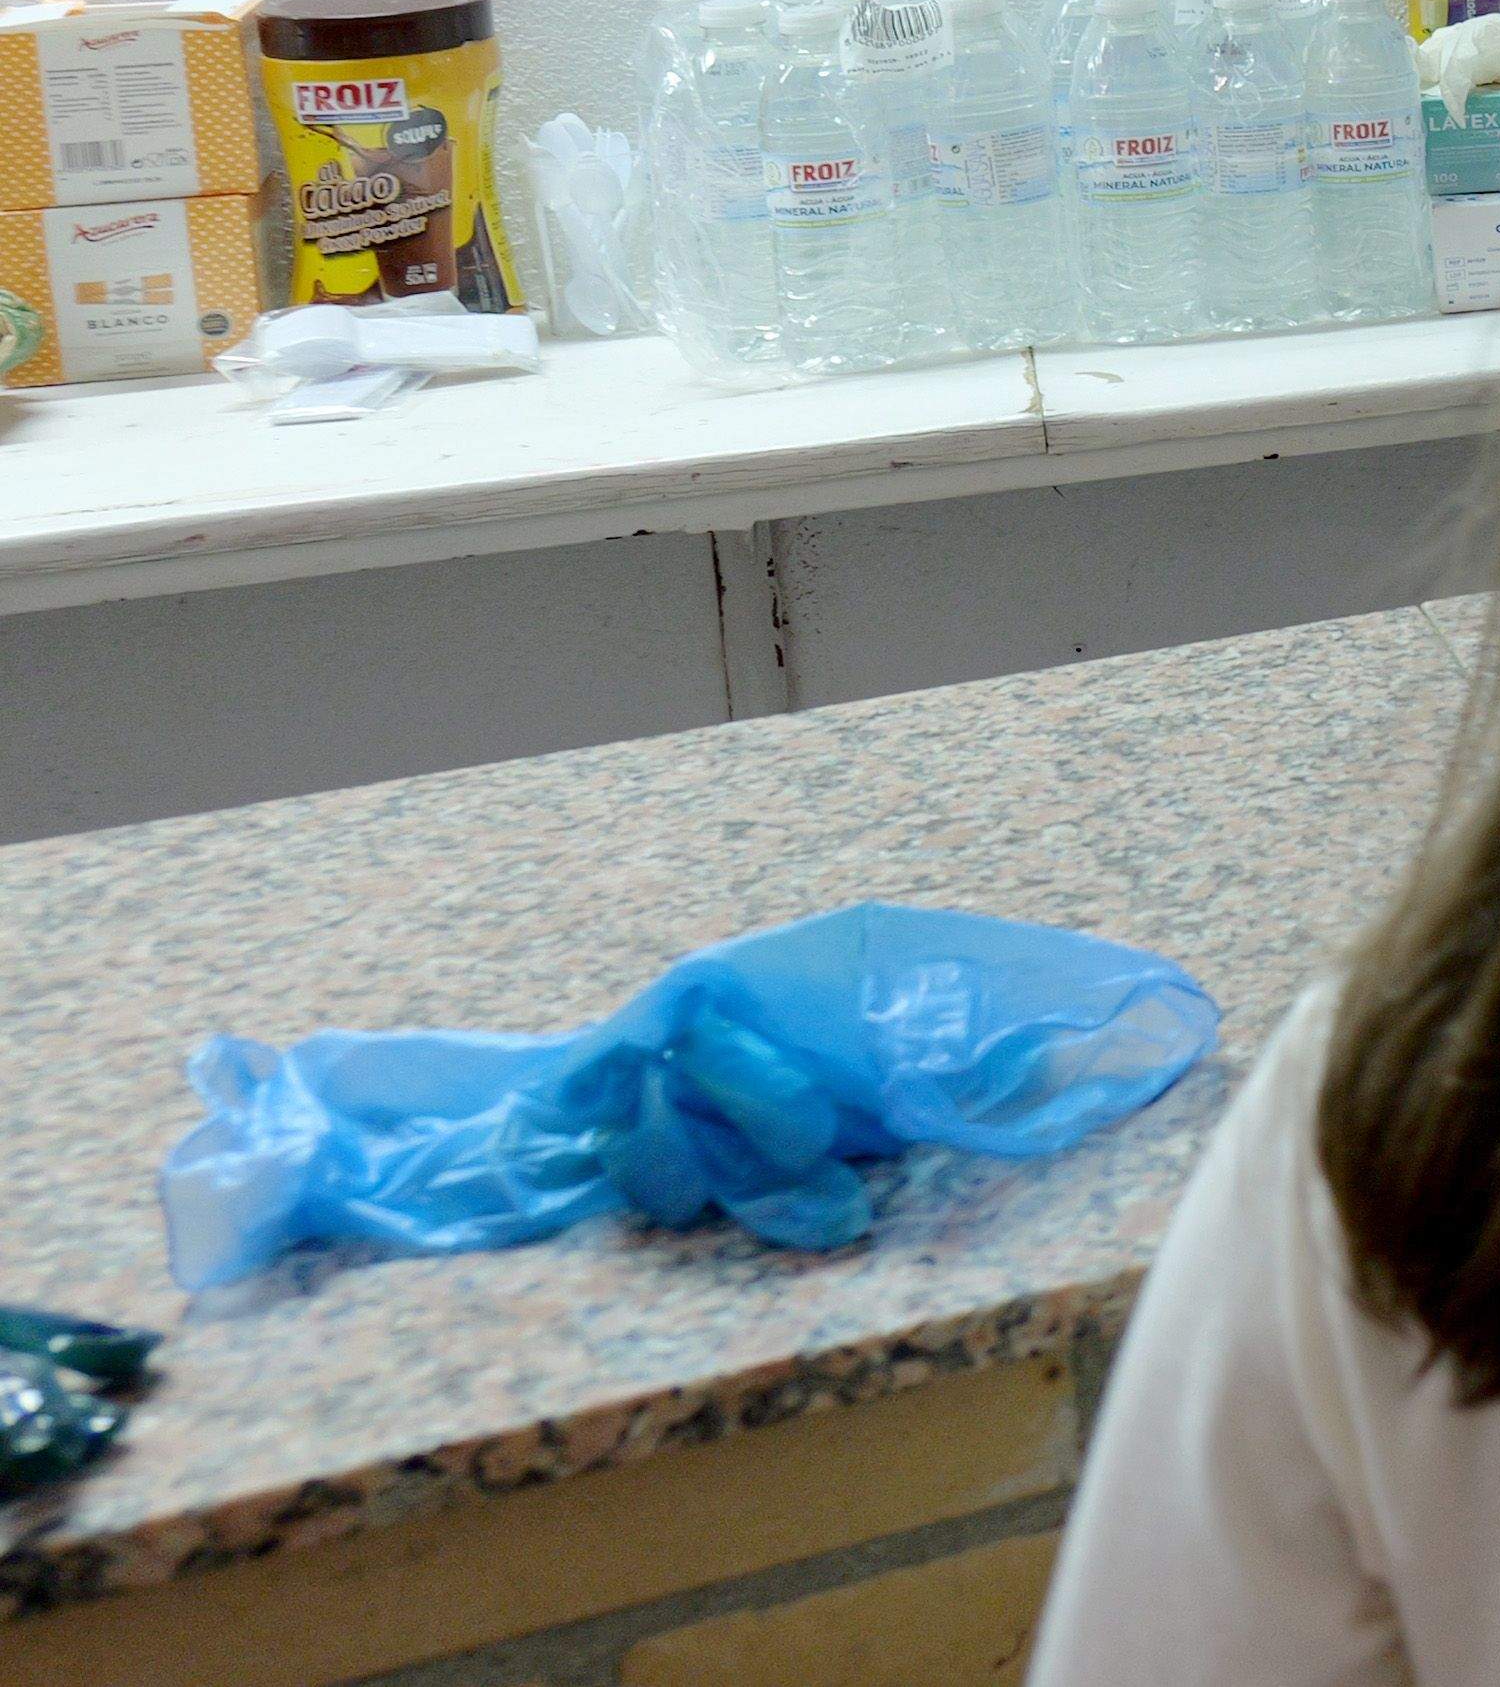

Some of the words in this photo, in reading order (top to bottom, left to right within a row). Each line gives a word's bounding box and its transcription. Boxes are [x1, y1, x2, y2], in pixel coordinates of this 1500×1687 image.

[296, 80, 402, 112] FROIZ
[1333, 121, 1389, 140] FROIZ
[1116, 136, 1174, 156] FROIZ
[792, 160, 855, 182] FROIZ
[87, 314, 169, 330] BLANCO
